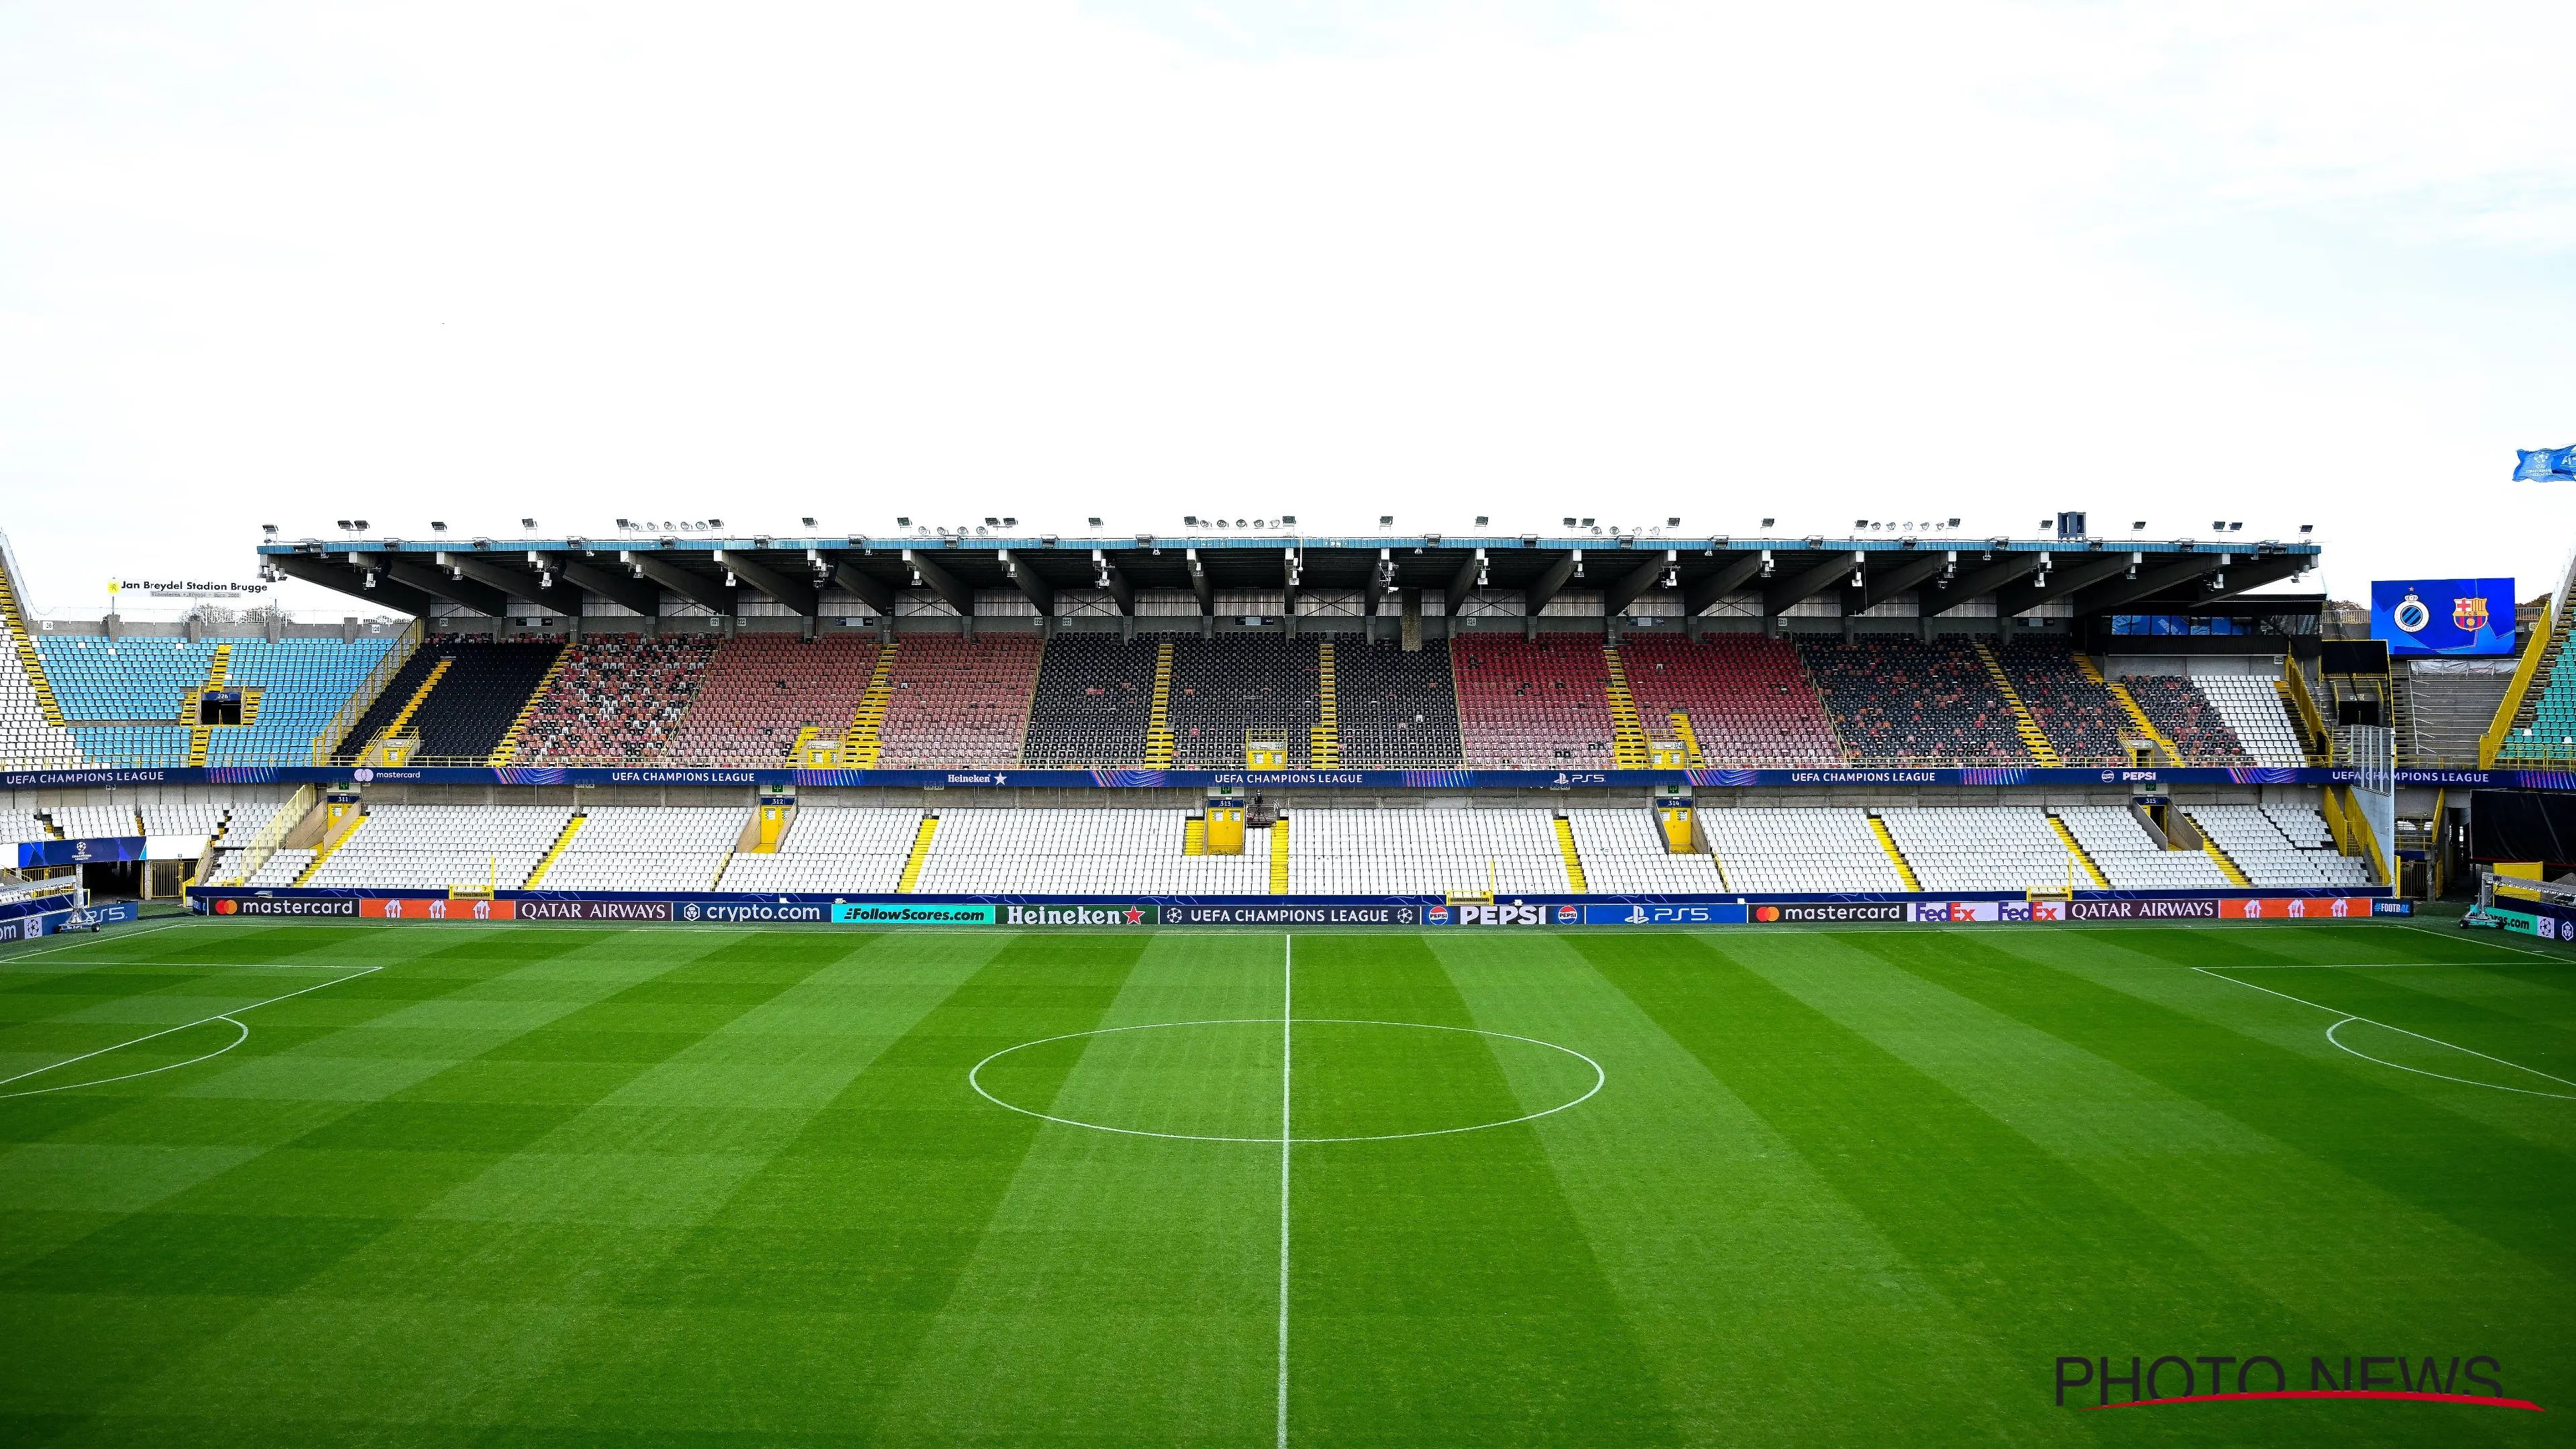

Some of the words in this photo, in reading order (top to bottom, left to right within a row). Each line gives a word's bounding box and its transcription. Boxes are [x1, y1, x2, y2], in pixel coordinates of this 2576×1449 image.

[121, 581, 140, 589] Jan
[144, 581, 182, 592] Breydel
[186, 582, 227, 590] Stadion
[231, 582, 268, 594] Brugge
[7, 775, 36, 784] UEFA
[40, 773, 113, 783] CHAMPIONS
[117, 771, 164, 781] LEAGUE
[612, 772, 641, 781] UEFA
[643, 772, 709, 781] CHAMPIONS
[712, 773, 755, 782] LEAGUE
[948, 774, 990, 783] Heineken
[1215, 774, 1244, 783] UEFA
[1246, 774, 1316, 783] CHAMPIONS
[1318, 774, 1363, 783] LEAGUE
[1572, 774, 1604, 782] PS5
[1792, 773, 1819, 782] UEFA
[1823, 773, 1890, 782] CHAMPIONS
[1892, 773, 1935, 782] LEAGUE
[2123, 772, 2157, 781] PEPSI
[2332, 771, 2361, 780] UEFA
[2365, 771, 2438, 781] CHAMPIONS
[2441, 773, 2489, 782] LEAGUE
[244, 900, 353, 914] mastercard
[522, 903, 582, 920] QATAR
[590, 904, 665, 918] AIRWAYS
[706, 904, 820, 922] crypto.com
[1785, 906, 1899, 919] mastercard
[1915, 902, 1976, 922] FedEx
[1998, 902, 2057, 922] FedEx
[2072, 902, 2131, 920] QATAR
[2139, 902, 2214, 917] AIRWAYS
[844, 908, 985, 921] FollowScores.com
[1008, 906, 1121, 924] Heineken
[1191, 910, 1231, 922] UEFA
[1235, 910, 1325, 922] CHAMPIONS
[1331, 910, 1388, 922] LEAGUE
[1460, 906, 1546, 925] PEPSI
[1654, 908, 1711, 921] PS5
